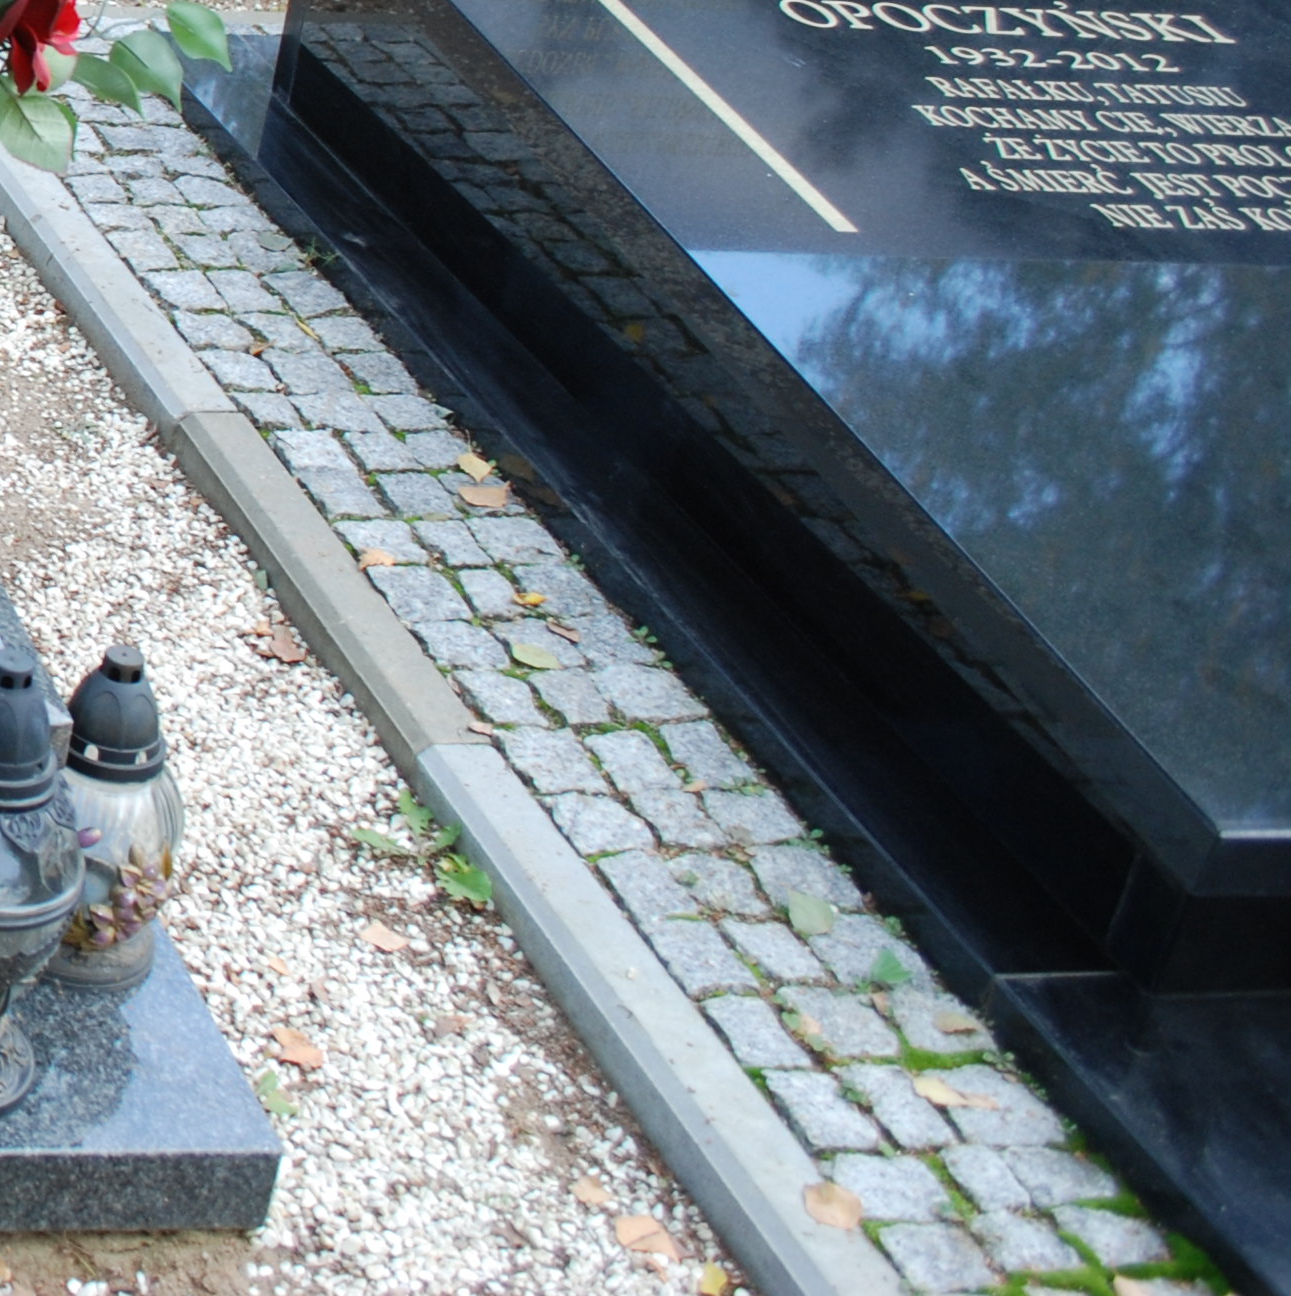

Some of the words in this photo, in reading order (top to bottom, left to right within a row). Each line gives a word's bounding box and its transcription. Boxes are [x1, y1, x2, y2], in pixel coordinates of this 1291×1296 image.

[924, 46, 1181, 73] 1932-2012
[912, 104, 1098, 132] KOCHAMY
[983, 132, 1043, 160] ŻE
[1034, 134, 1151, 164] ŻYCIE
[1139, 141, 1203, 165] TO
[960, 167, 997, 191] A
[980, 160, 1134, 195] ŚMIERĆ
[1130, 172, 1222, 200] JEST
[1089, 203, 1174, 229] NIE
[1168, 197, 1248, 231] ZAŚ
